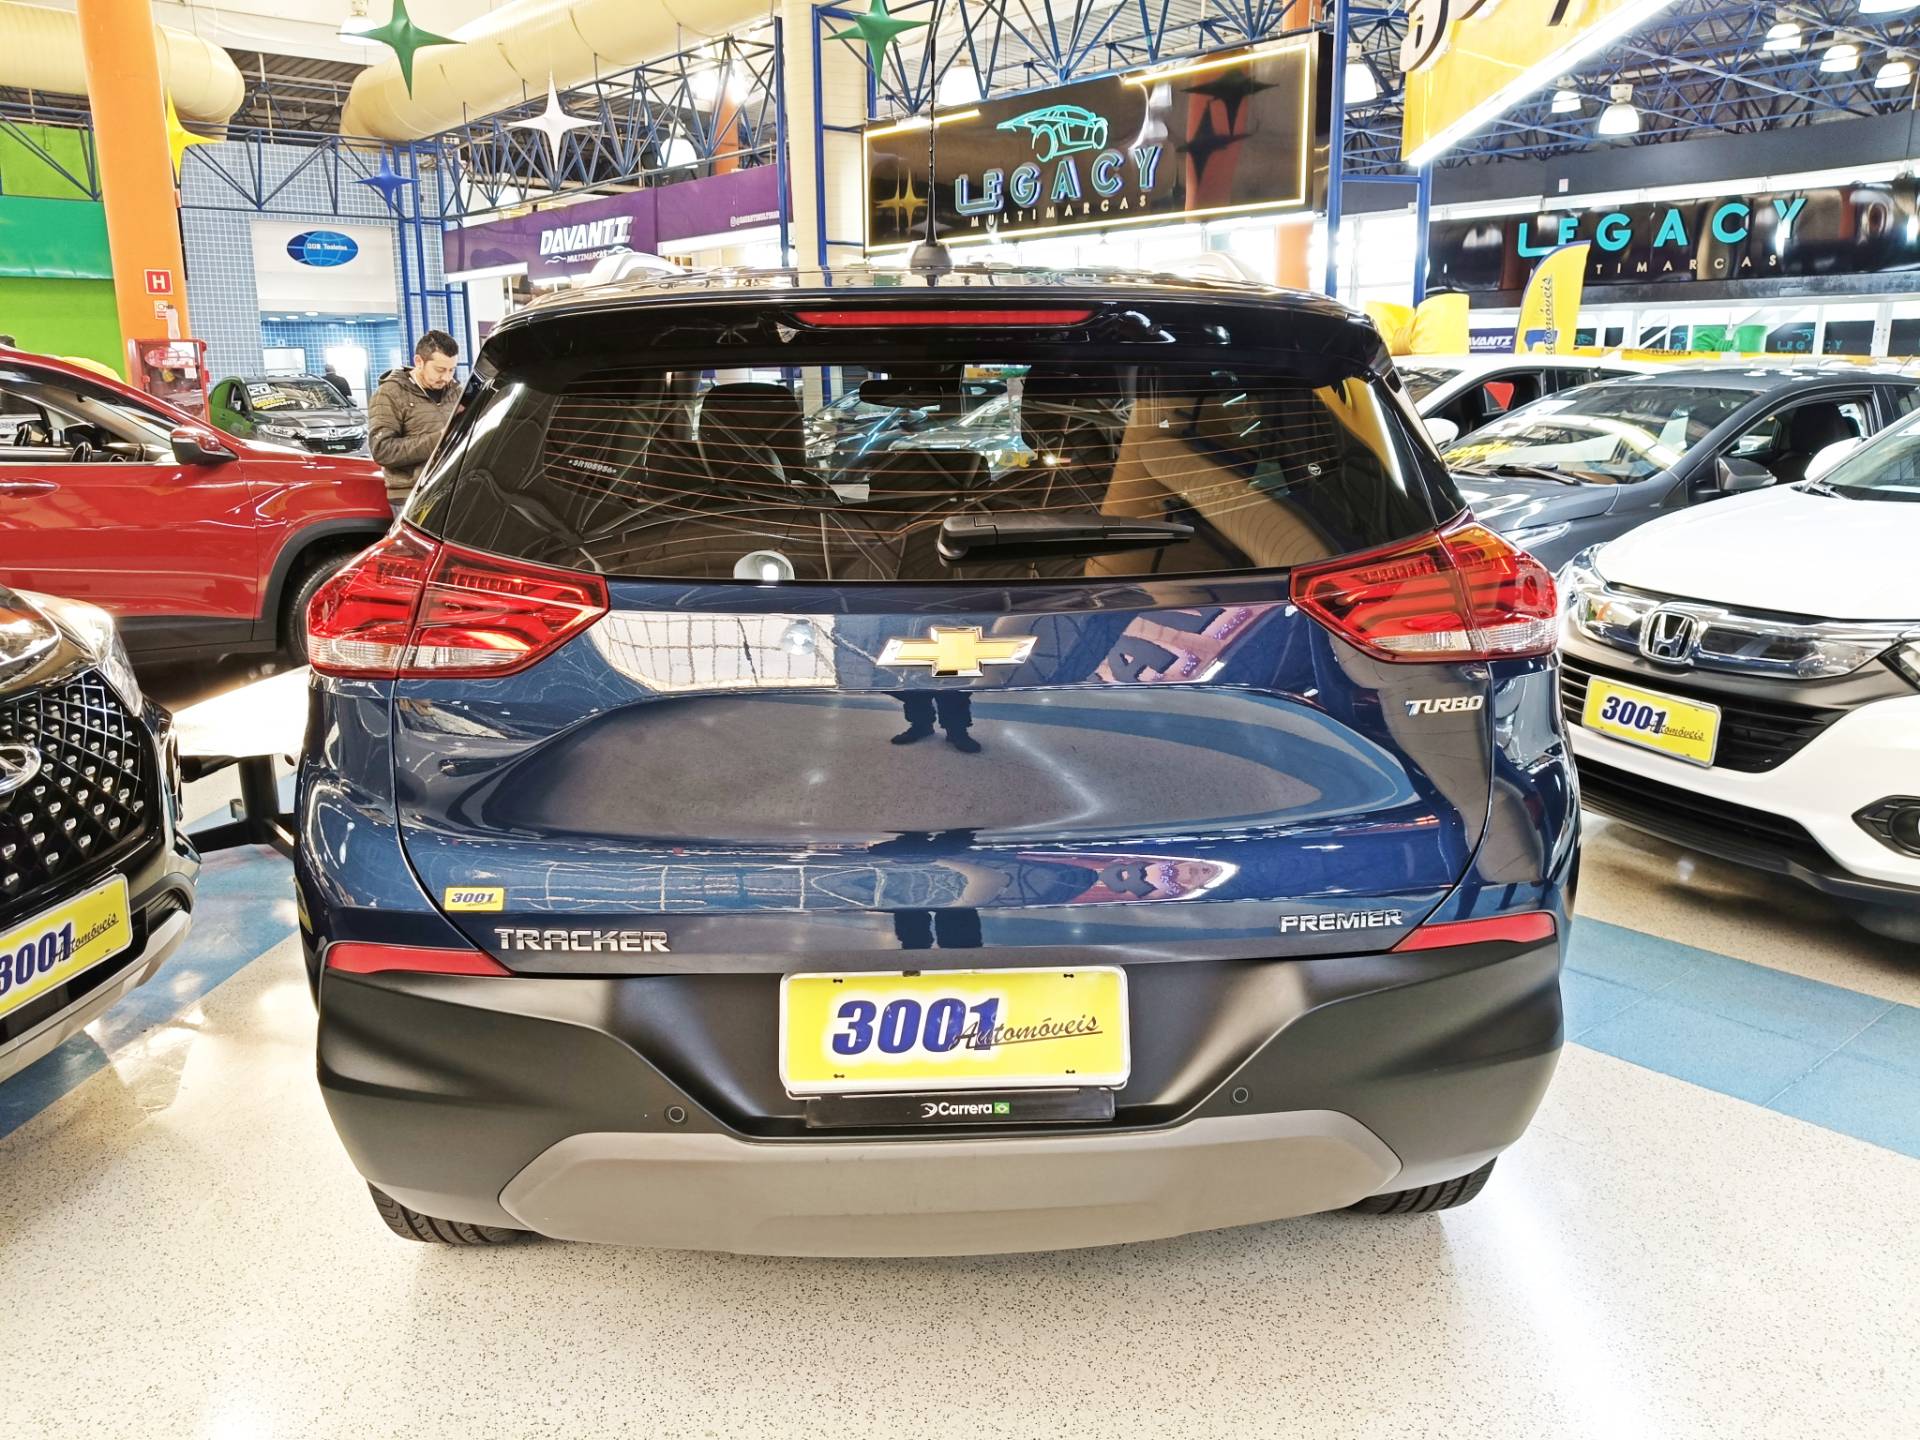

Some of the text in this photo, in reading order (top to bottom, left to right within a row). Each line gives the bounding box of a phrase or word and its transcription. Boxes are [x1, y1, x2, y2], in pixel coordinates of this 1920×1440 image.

[955, 145, 1162, 216] LEGACY
[970, 194, 1146, 227] MULTIMARCAS
[540, 216, 633, 255] DAVANTI
[1517, 198, 1806, 258] LEGACY
[152, 274, 166, 290] H
[1405, 695, 1484, 716] TURBO
[1602, 696, 1667, 734] 3001
[452, 892, 494, 903] 3001
[1280, 909, 1403, 933] PREMIER
[494, 928, 671, 952] TRACKER
[832, 998, 1102, 1055] 3001 Automóveis
[938, 1102, 993, 1116] Carrera
